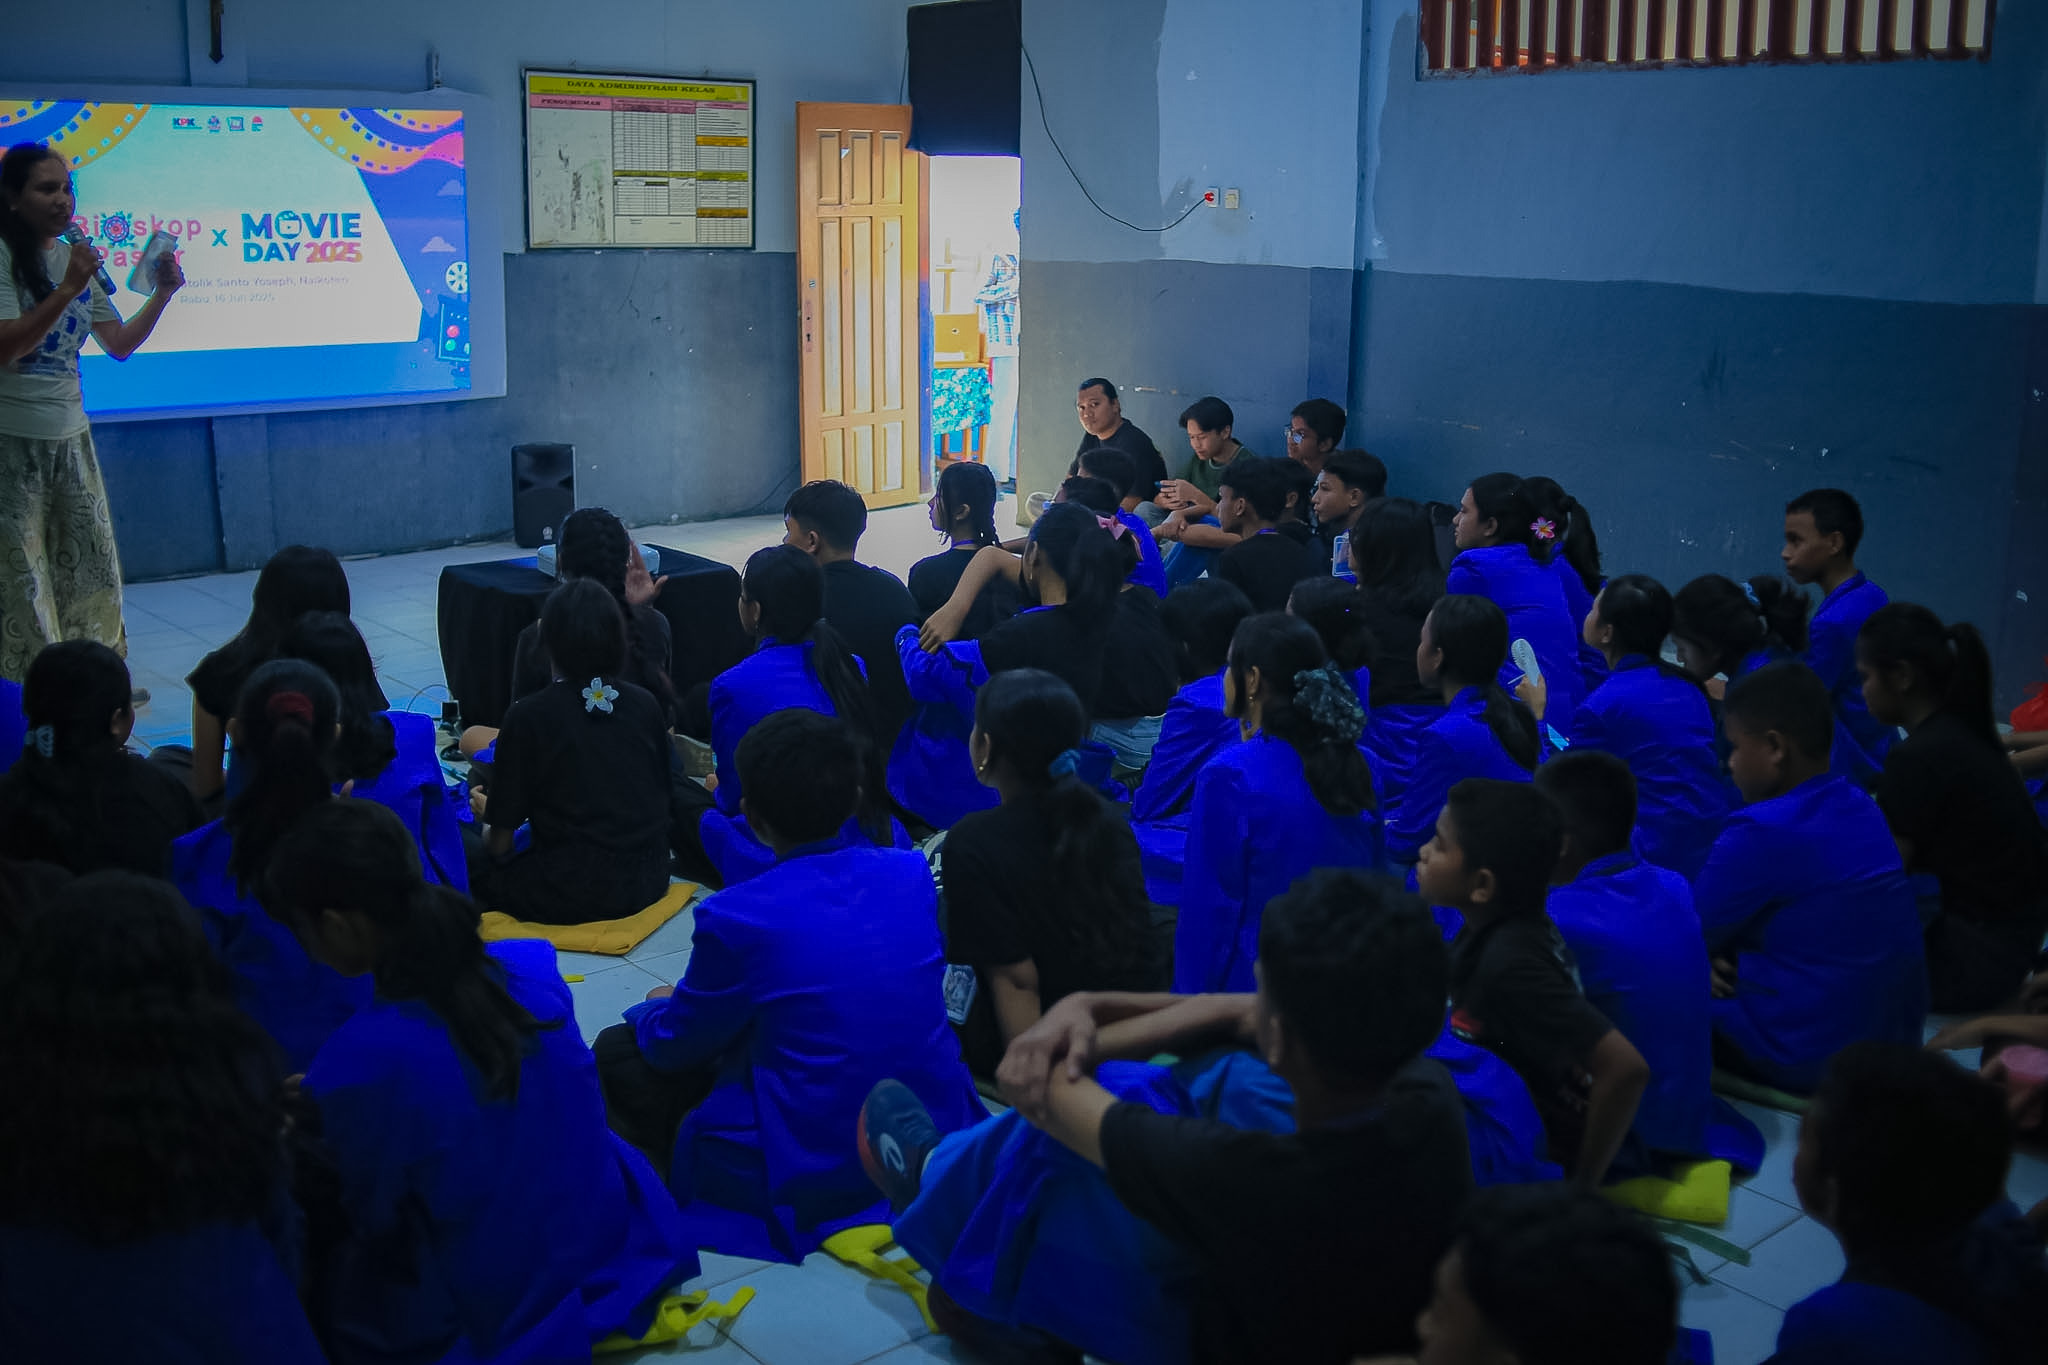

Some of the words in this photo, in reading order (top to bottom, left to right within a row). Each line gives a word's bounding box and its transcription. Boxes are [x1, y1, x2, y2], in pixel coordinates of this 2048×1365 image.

[567, 80, 596, 89] DATA
[598, 82, 679, 93] ADMINISTRASI
[681, 86, 716, 94] KELAS
[241, 210, 362, 239] MOVIE
[97, 245, 185, 268] Pasr
[243, 241, 301, 263] DAY
[303, 240, 363, 263] 2025
[185, 277, 213, 289] tolik
[216, 277, 249, 288] Santo
